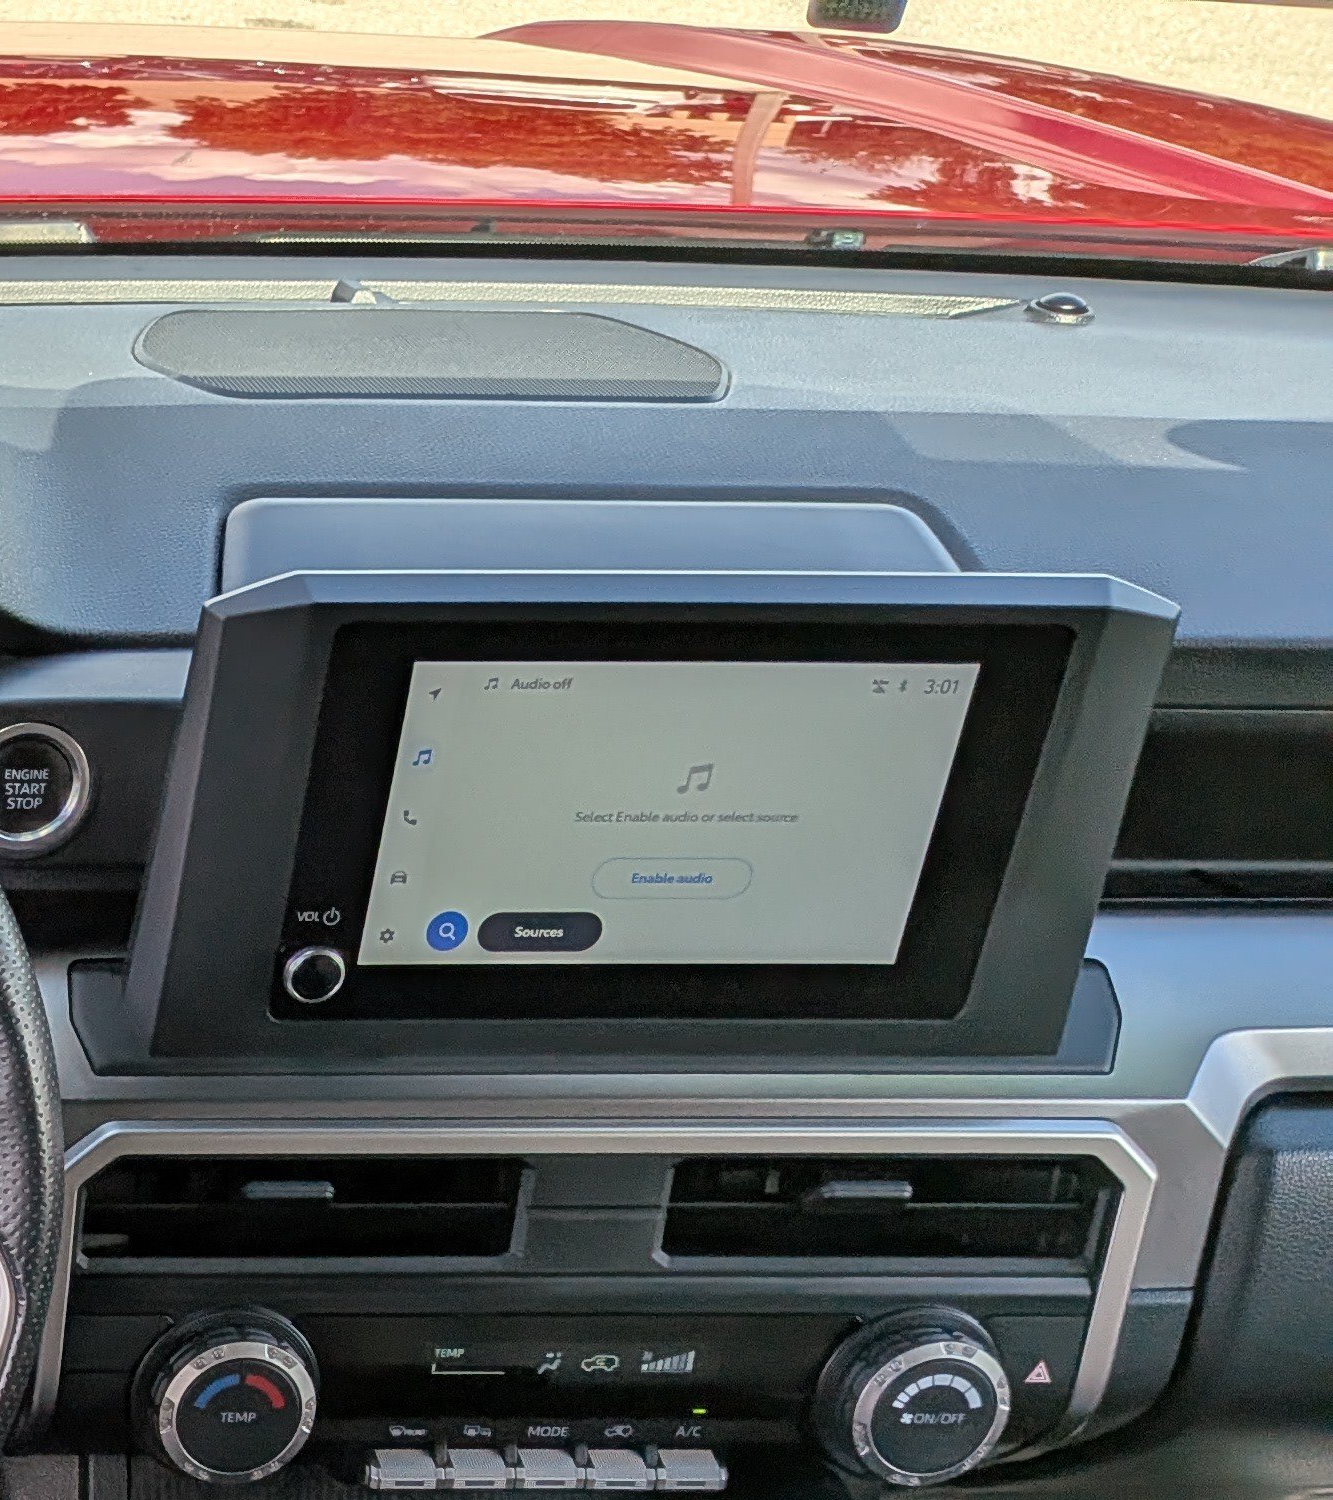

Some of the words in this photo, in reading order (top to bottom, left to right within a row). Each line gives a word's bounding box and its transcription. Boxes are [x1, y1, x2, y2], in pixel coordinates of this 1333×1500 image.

[511, 677, 551, 691] Audio
[553, 677, 573, 691] off
[923, 679, 960, 695] 3:01
[4, 768, 50, 780] ENGINE
[4, 782, 47, 795] START
[6, 797, 43, 810] STOP
[575, 811, 614, 823] Select
[616, 811, 660, 823] Enable
[662, 811, 699, 823] audio
[701, 813, 714, 823] or
[718, 811, 755, 823] select
[631, 872, 675, 884] Enable
[676, 872, 714, 884] audio
[297, 911, 320, 922] VOL
[514, 926, 564, 939] Sources
[435, 1348, 465, 1358] TEMP
[220, 1411, 257, 1424] TEMP
[913, 1412, 967, 1424] ON/OFF
[527, 1426, 570, 1438] MODE
[676, 1426, 702, 1438] A/C
